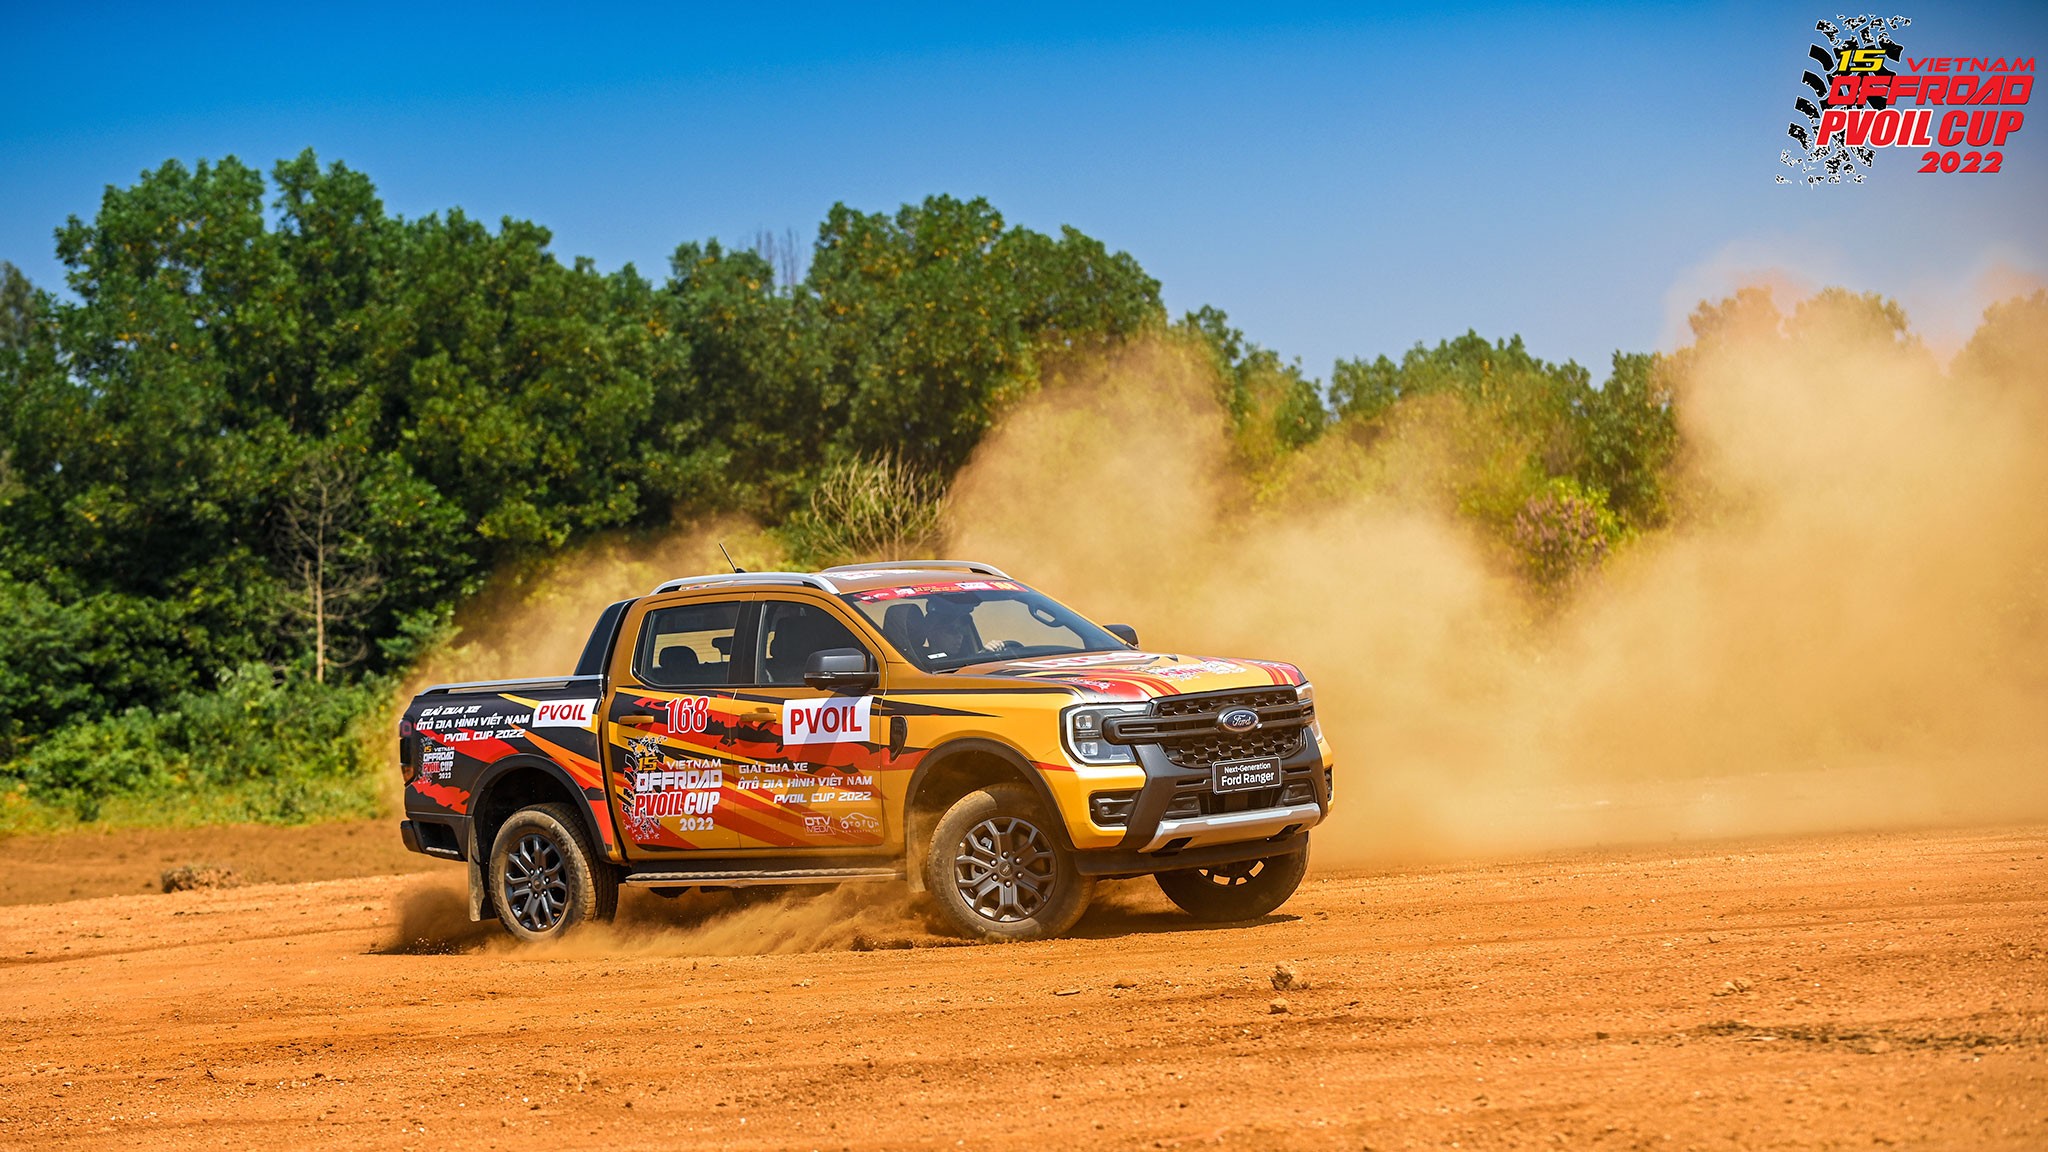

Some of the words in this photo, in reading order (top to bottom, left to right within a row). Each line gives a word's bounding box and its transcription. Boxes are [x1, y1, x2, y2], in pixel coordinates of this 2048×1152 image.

[538, 704, 587, 721] PVOIL
[666, 696, 710, 734] 168
[480, 712, 503, 729] VIỆT
[504, 714, 531, 725] NAM
[790, 706, 862, 735] PVOIL
[1231, 714, 1252, 727] Ford
[443, 732, 471, 743] PVOIL
[472, 730, 494, 741] CUP
[494, 728, 527, 739] 2022
[422, 761, 441, 774] PVOIL
[440, 760, 454, 773] CUP
[638, 756, 658, 771] 15
[666, 758, 722, 770] VIETNAM
[792, 762, 808, 772] XE
[1224, 762, 1271, 774] Next-Generation
[635, 769, 723, 792] OFFROAD
[786, 774, 815, 788] HÌNH
[817, 772, 843, 790] VIỆT
[846, 775, 873, 786] NAM
[1221, 773, 1242, 787] Ford
[1243, 772, 1275, 784] Ranger
[633, 791, 682, 817] PVOIL
[683, 791, 720, 815] CUP
[773, 793, 807, 804] PVOIL
[811, 792, 835, 803] CUP
[837, 791, 872, 802] 2022
[679, 816, 714, 832] 2022
